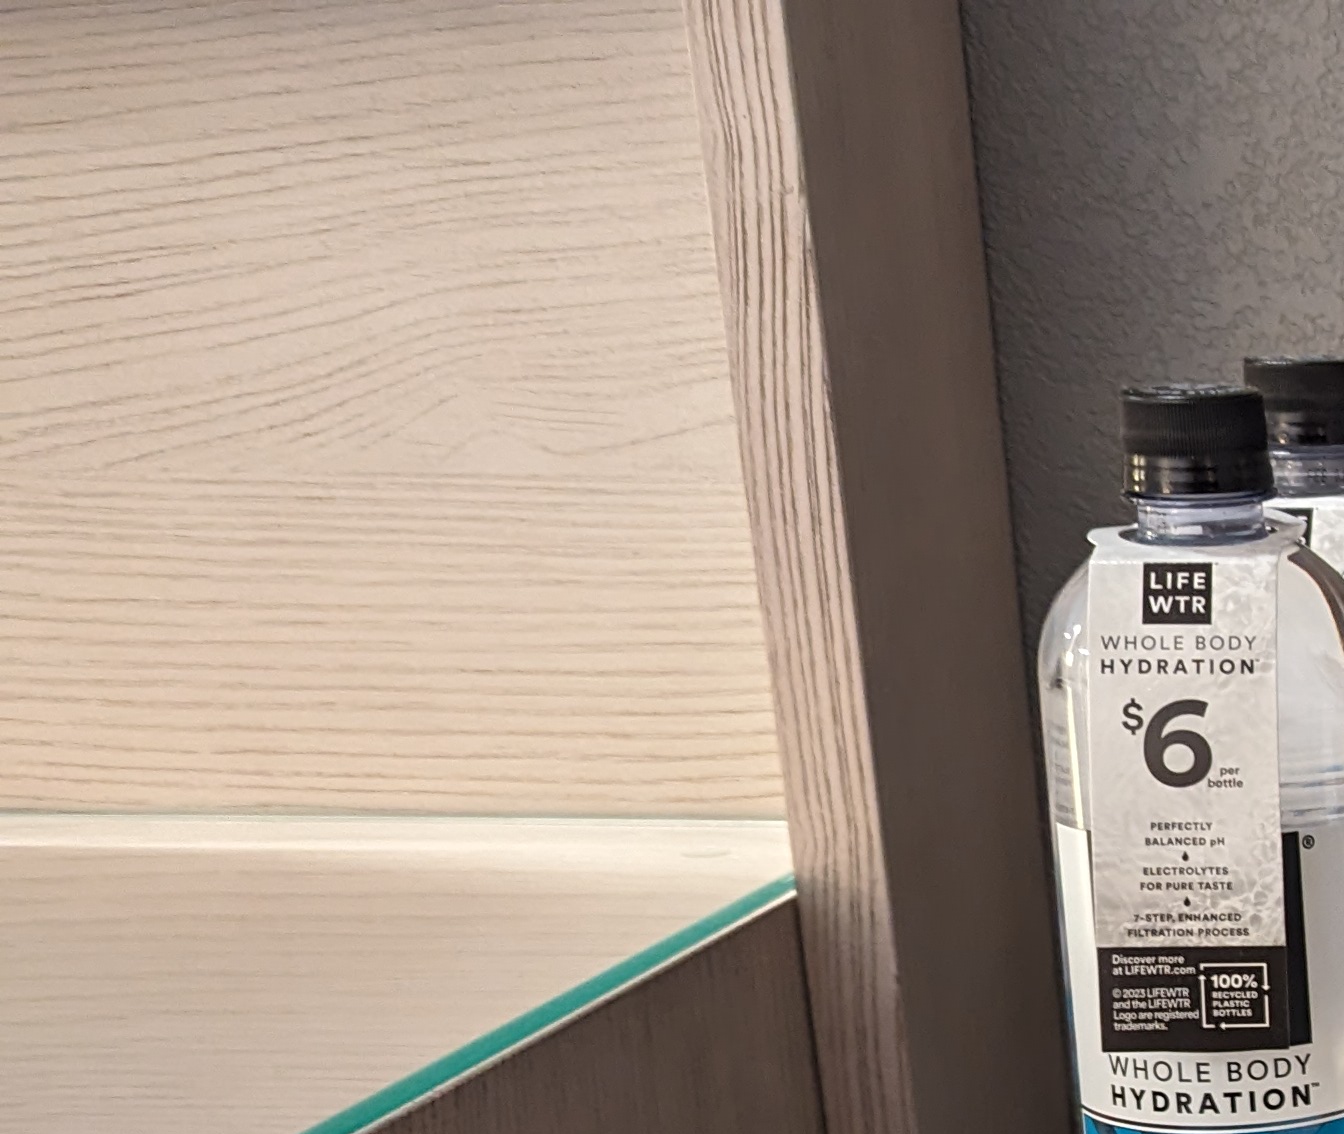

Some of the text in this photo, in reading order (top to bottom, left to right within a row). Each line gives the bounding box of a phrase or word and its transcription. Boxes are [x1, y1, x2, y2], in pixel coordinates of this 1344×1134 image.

[1150, 571, 1207, 590] LIFE
[1148, 595, 1206, 614] WTR
[1100, 635, 1257, 651] WHOLE BODY
[1219, 766, 1240, 777] per
[1207, 778, 1244, 788] bottle
[1150, 821, 1213, 831] PERFECTLY
[1144, 837, 1226, 848] BALANCED pH
[1142, 866, 1229, 876] ELECTROLYTES
[1139, 881, 1234, 891] FOR PURE TASTE
[1133, 913, 1242, 923] 7-STEP, ENHANCED
[1127, 928, 1250, 938] FILTRATION PROCESS
[1111, 954, 1185, 965] Discover more
[1112, 965, 1197, 976] at LIFEWTR.com
[1210, 973, 1258, 989] 100%
[1122, 988, 1146, 998] 2023
[1147, 987, 1190, 998] LIFEWTR
[1211, 990, 1259, 999] RECYCLED
[1112, 998, 1191, 1009] and the LIFEWTR
[1212, 999, 1250, 1008] PLASTIC
[1113, 1009, 1200, 1022] Logo are registered
[1212, 1009, 1253, 1017] BOTTLES
[1113, 1021, 1169, 1031] trademarks.
[1107, 1052, 1312, 1083] WHOLE BODY
